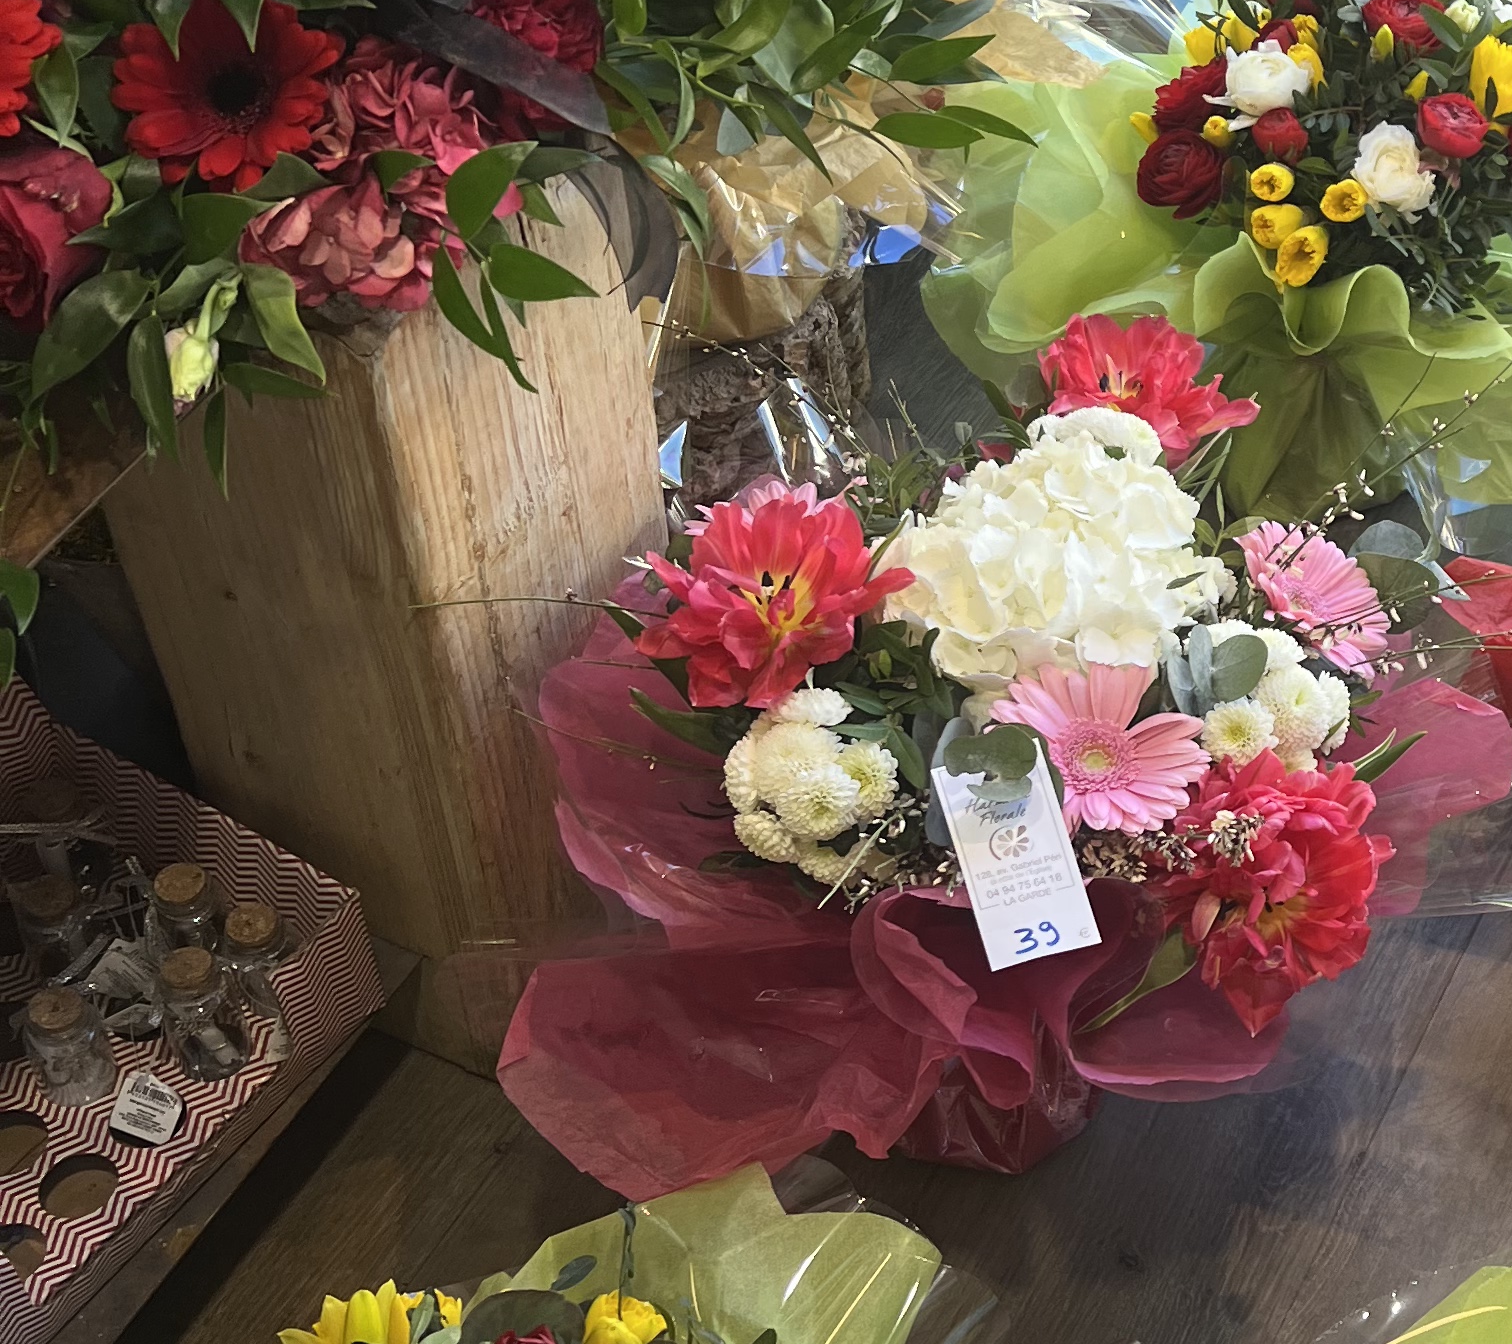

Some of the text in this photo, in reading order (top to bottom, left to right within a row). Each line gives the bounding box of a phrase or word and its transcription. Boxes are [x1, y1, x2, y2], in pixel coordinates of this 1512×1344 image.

[980, 803, 1026, 827] Florale
[1010, 857, 1042, 871] Gabriel
[986, 888, 999, 899] 04
[1017, 879, 1031, 891] 75
[1033, 875, 1046, 887] 64
[1048, 872, 1062, 882] 18
[1003, 887, 1052, 907] LA GARDE
[1013, 920, 1061, 955] 39
